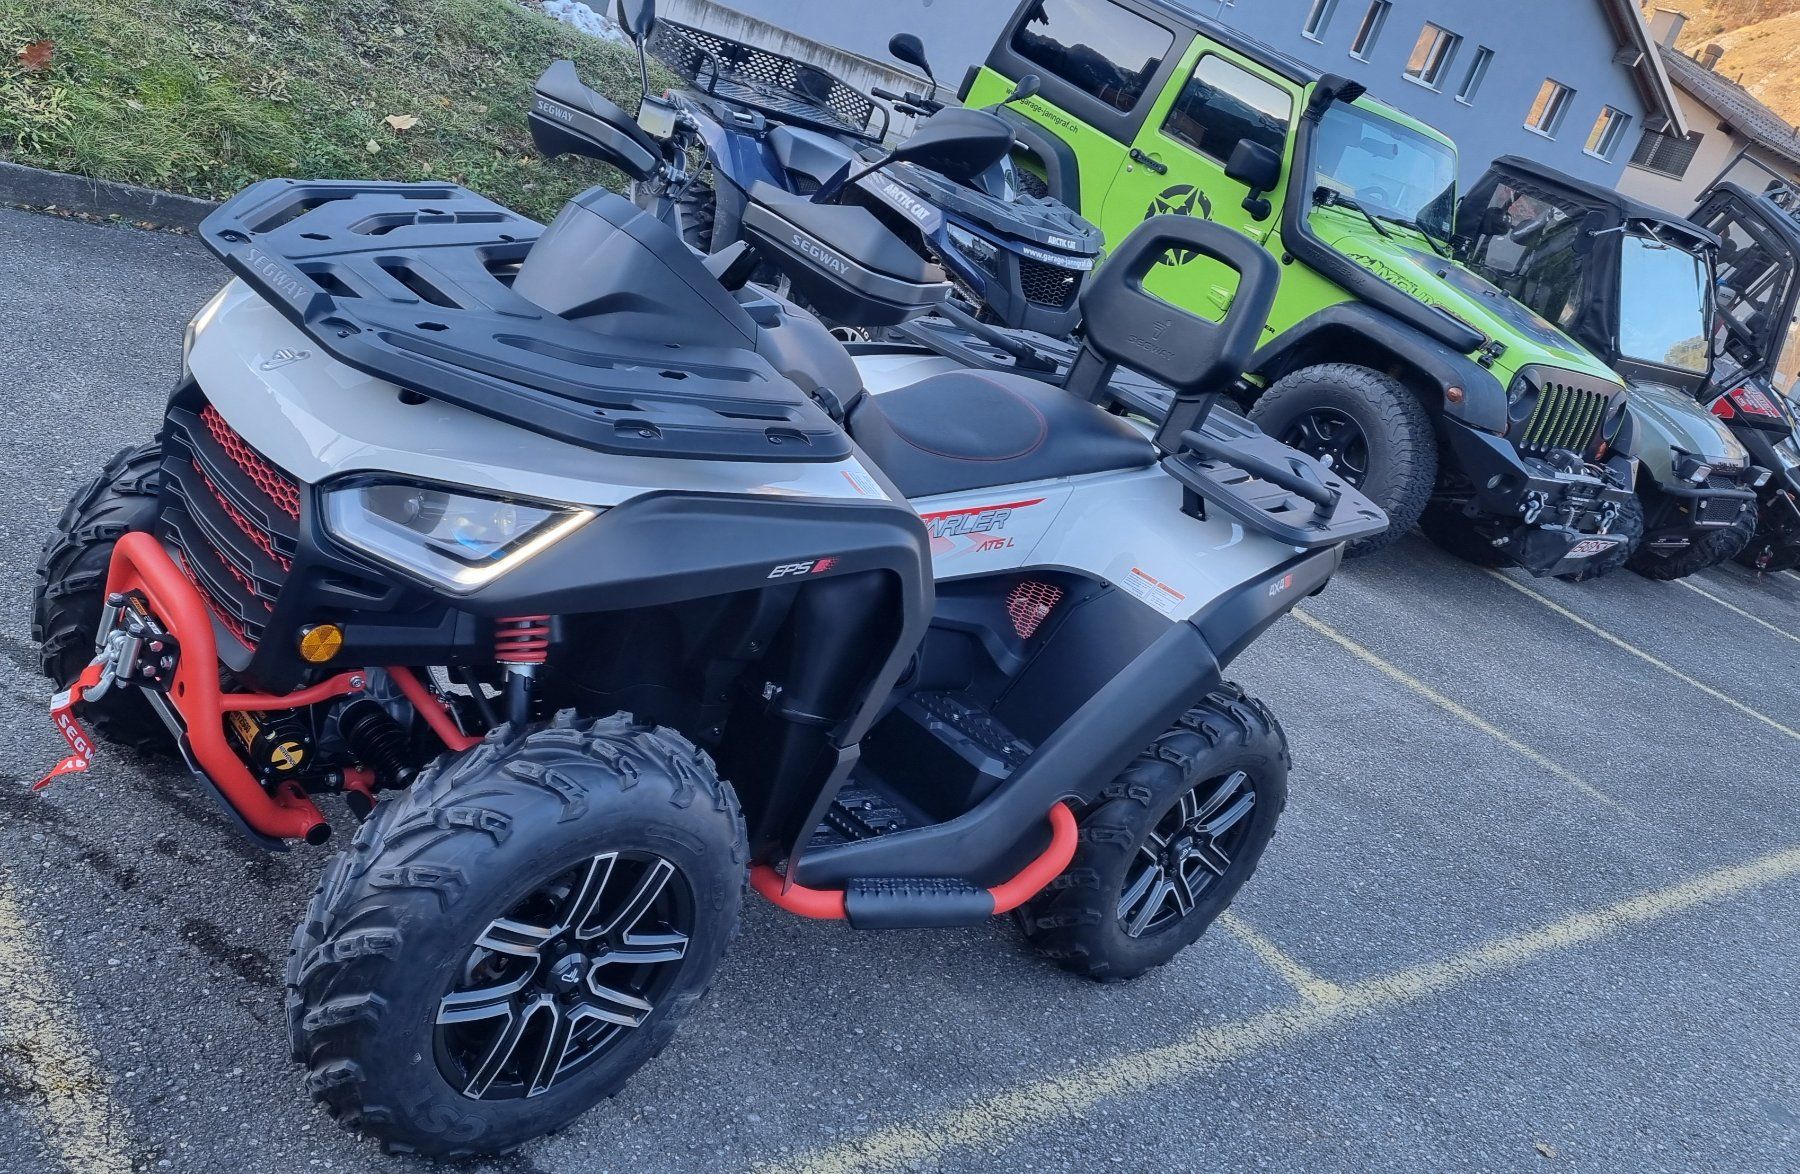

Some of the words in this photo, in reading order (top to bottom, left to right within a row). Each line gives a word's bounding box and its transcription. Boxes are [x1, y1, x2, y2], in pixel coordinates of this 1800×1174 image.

[537, 100, 574, 121] SEGWAY
[883, 184, 913, 210] ARCTIC
[910, 203, 931, 220] CAT
[1047, 235, 1067, 248] ARCTIC
[1067, 241, 1076, 250] CAT
[791, 234, 850, 275] SEGWAY
[246, 248, 309, 300] SEGWAY
[976, 538, 1006, 552] AT6
[1006, 537, 1015, 547] L
[766, 560, 815, 578] EPS
